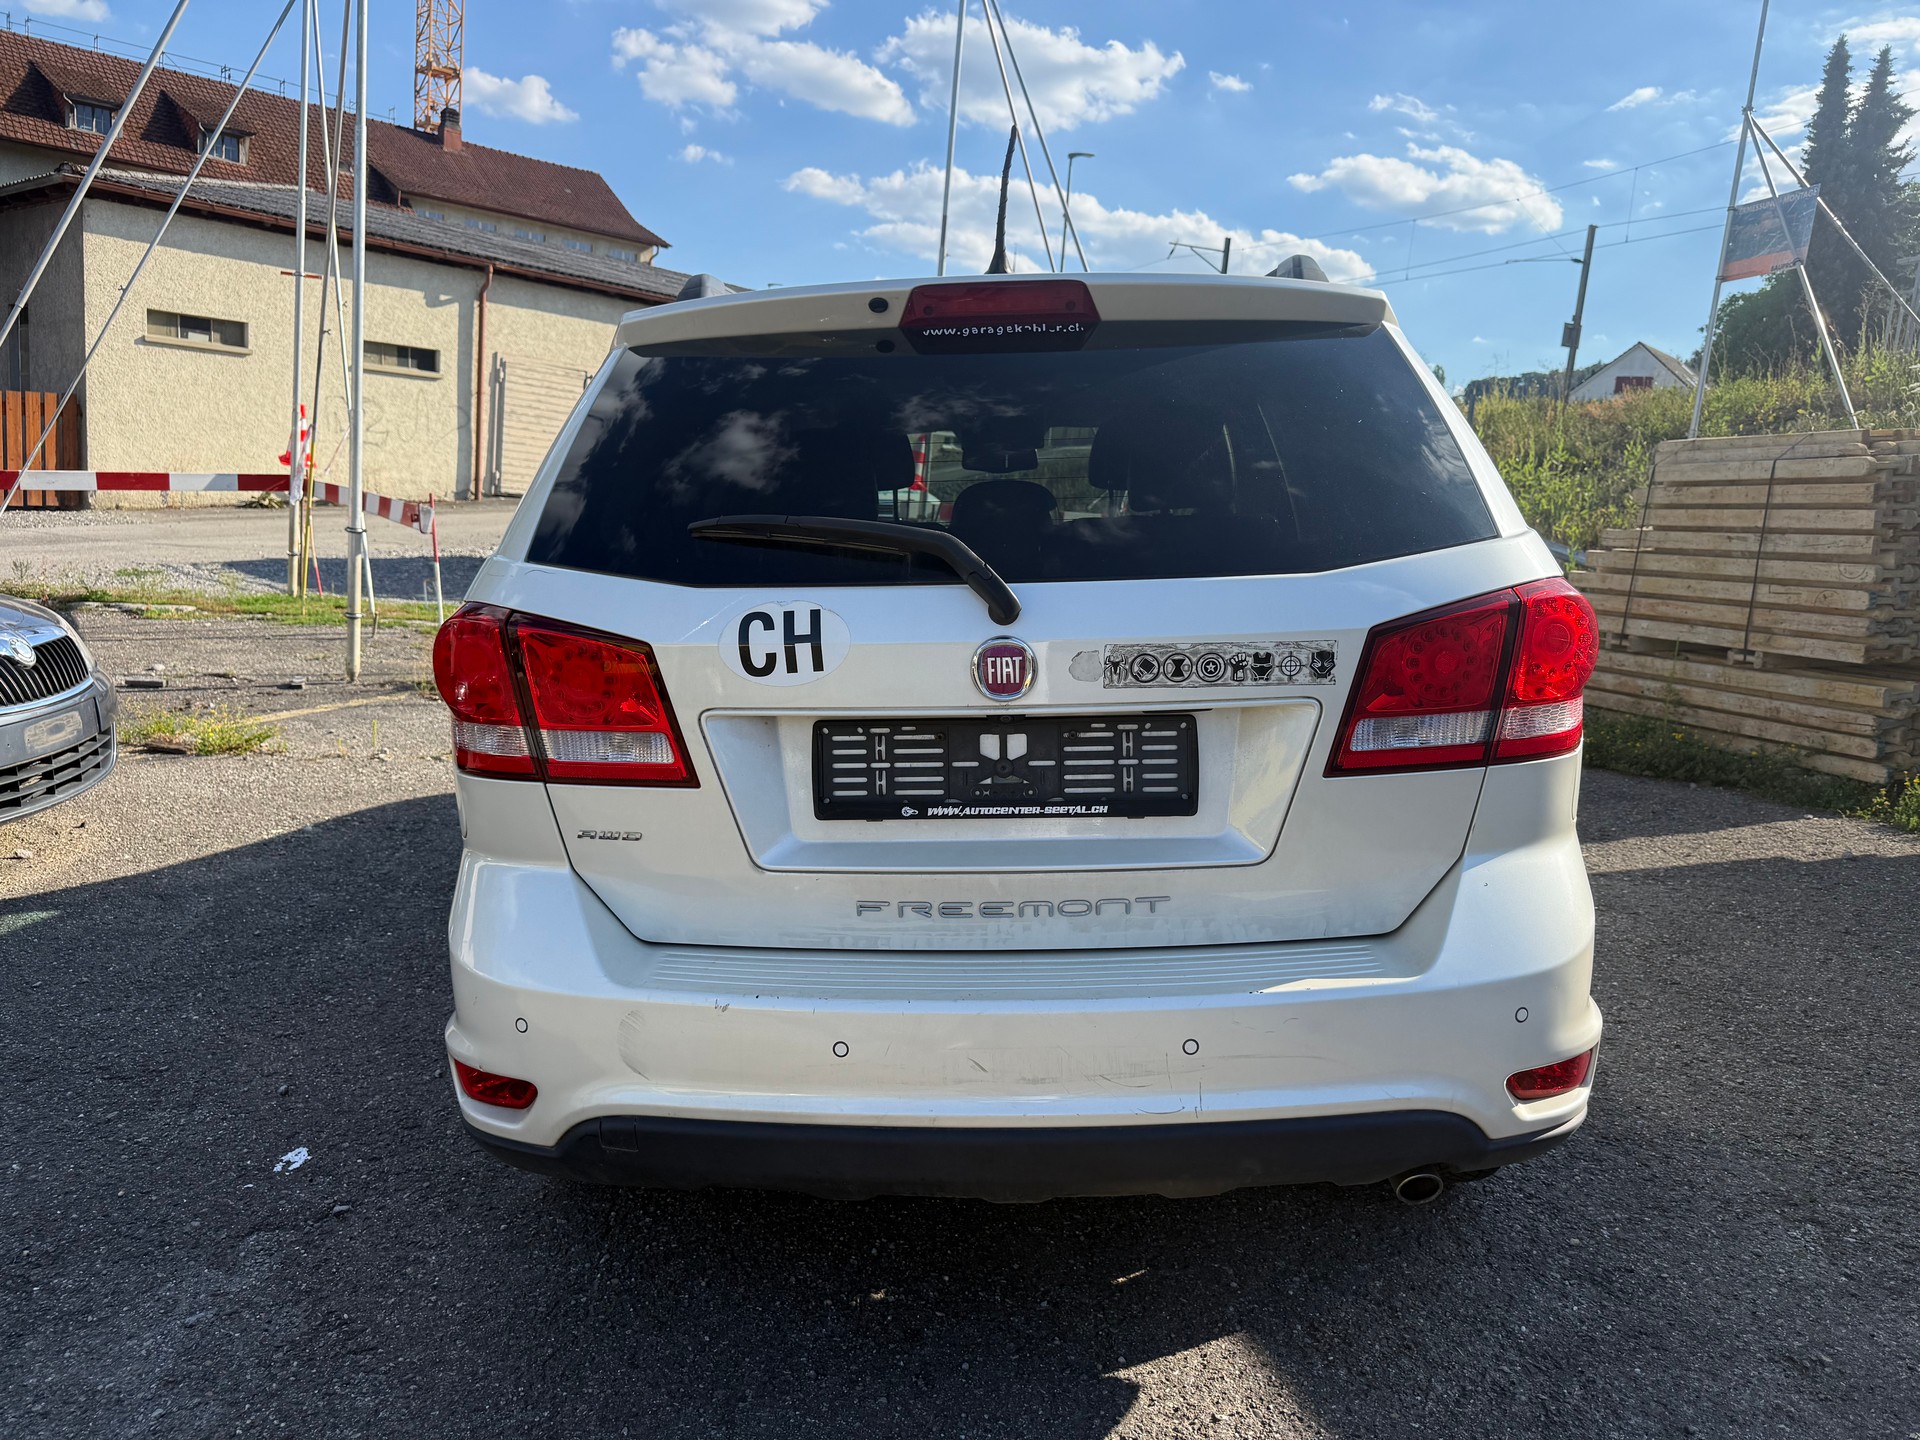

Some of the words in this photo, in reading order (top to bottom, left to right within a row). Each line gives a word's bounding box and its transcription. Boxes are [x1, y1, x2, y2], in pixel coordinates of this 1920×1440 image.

[738, 609, 824, 677] CH
[987, 656, 1023, 684] FIAT
[927, 805, 1109, 817] WWW.AUTOCENTER-SEETAL.CH
[577, 830, 643, 841] AWD
[856, 896, 1171, 918] FREEMONT
